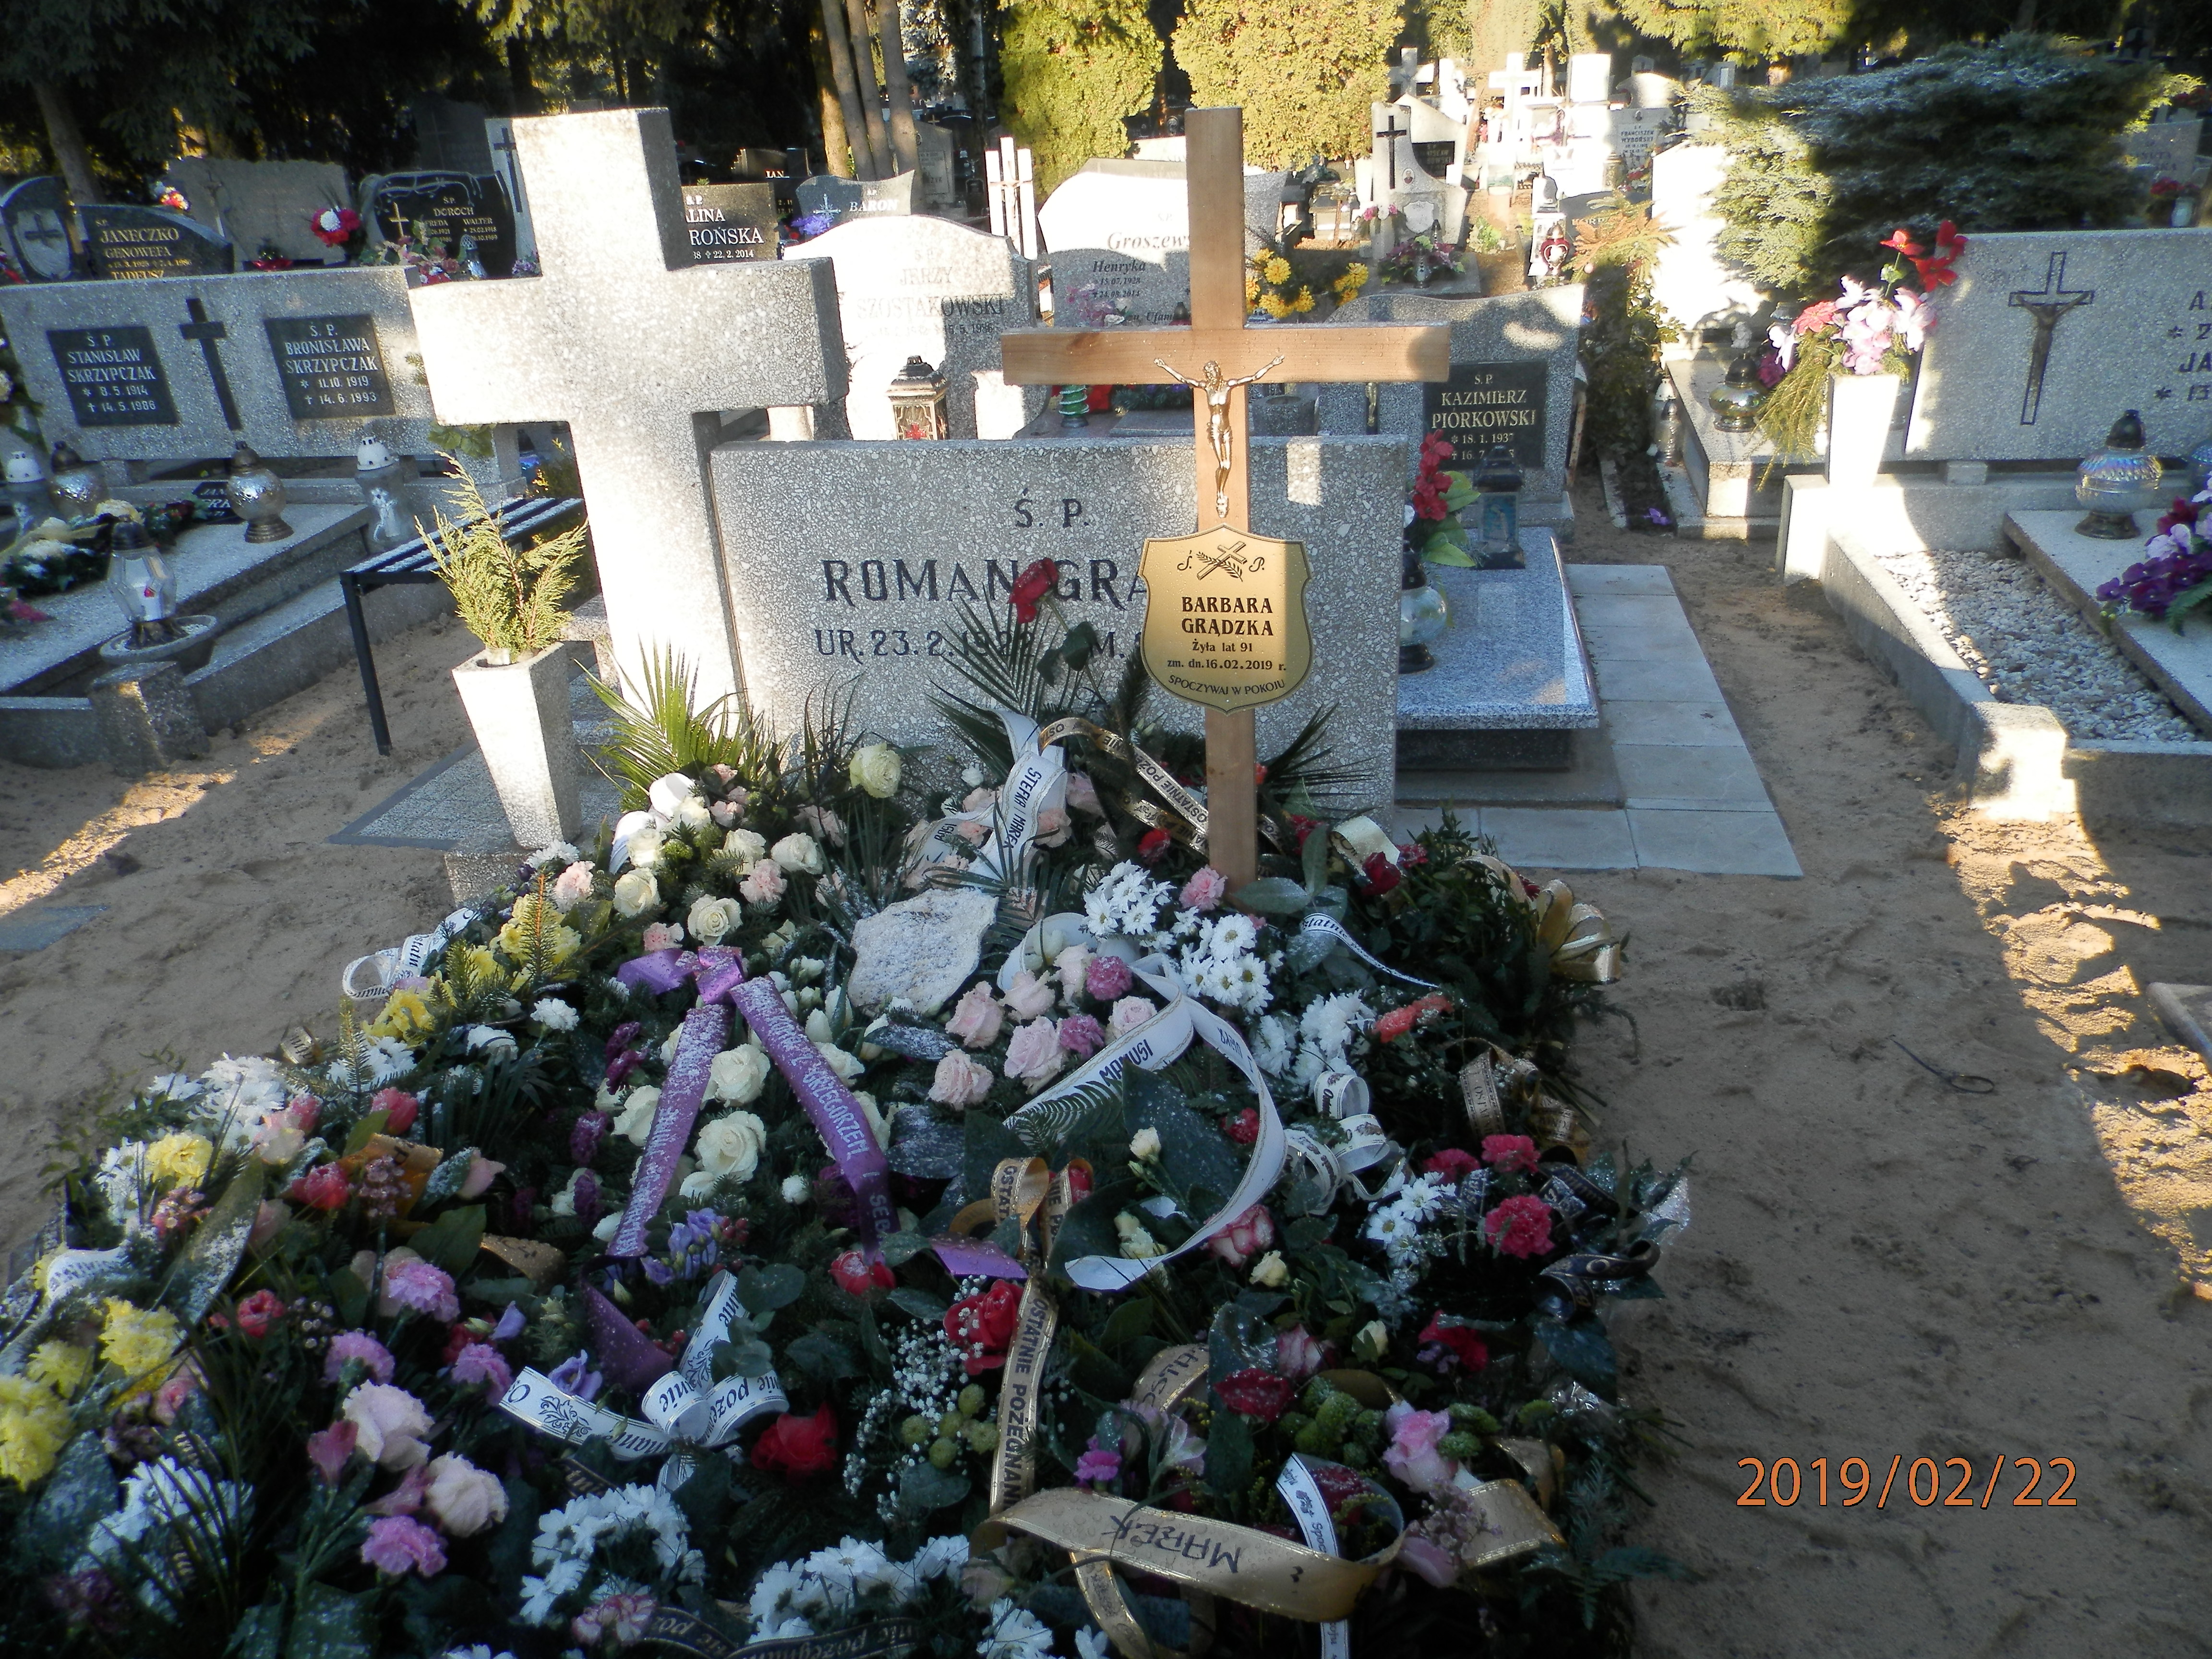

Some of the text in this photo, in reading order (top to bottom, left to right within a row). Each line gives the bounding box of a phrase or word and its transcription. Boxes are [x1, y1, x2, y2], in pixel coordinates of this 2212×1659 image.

[433, 207, 474, 216] DOROCH
[849, 199, 899, 212] BARON
[463, 217, 493, 226] WALTER
[100, 227, 180, 243] JANECZKO
[105, 246, 172, 258] GENOWEFA
[900, 266, 953, 285] JERZY
[1093, 260, 1146, 275] Henryka
[857, 293, 1005, 318] SZOSTAKOWSKI
[285, 337, 371, 355] BRONISŁAWA
[285, 356, 378, 374] SKRZYPCZAK
[67, 366, 156, 383] SKRZYPCZAK
[1442, 390, 1527, 406] KAZIMIERZ
[1431, 408, 1536, 429] PIÓRKOWSKI
[1062, 498, 1090, 528] P.
[1181, 596, 1273, 614] BARBARA
[1181, 618, 1274, 637] GRĄDZKA
[1192, 638, 1253, 653] Żyła lat 91
[1167, 659, 1184, 668] zm.
[1278, 663, 1287, 672] r.
[1168, 674, 1286, 696] SPOCZYWAJ W POKOJU
[1015, 1298, 1049, 1375] OSTATNIE
[1101, 1515, 1242, 1575] MAREK
